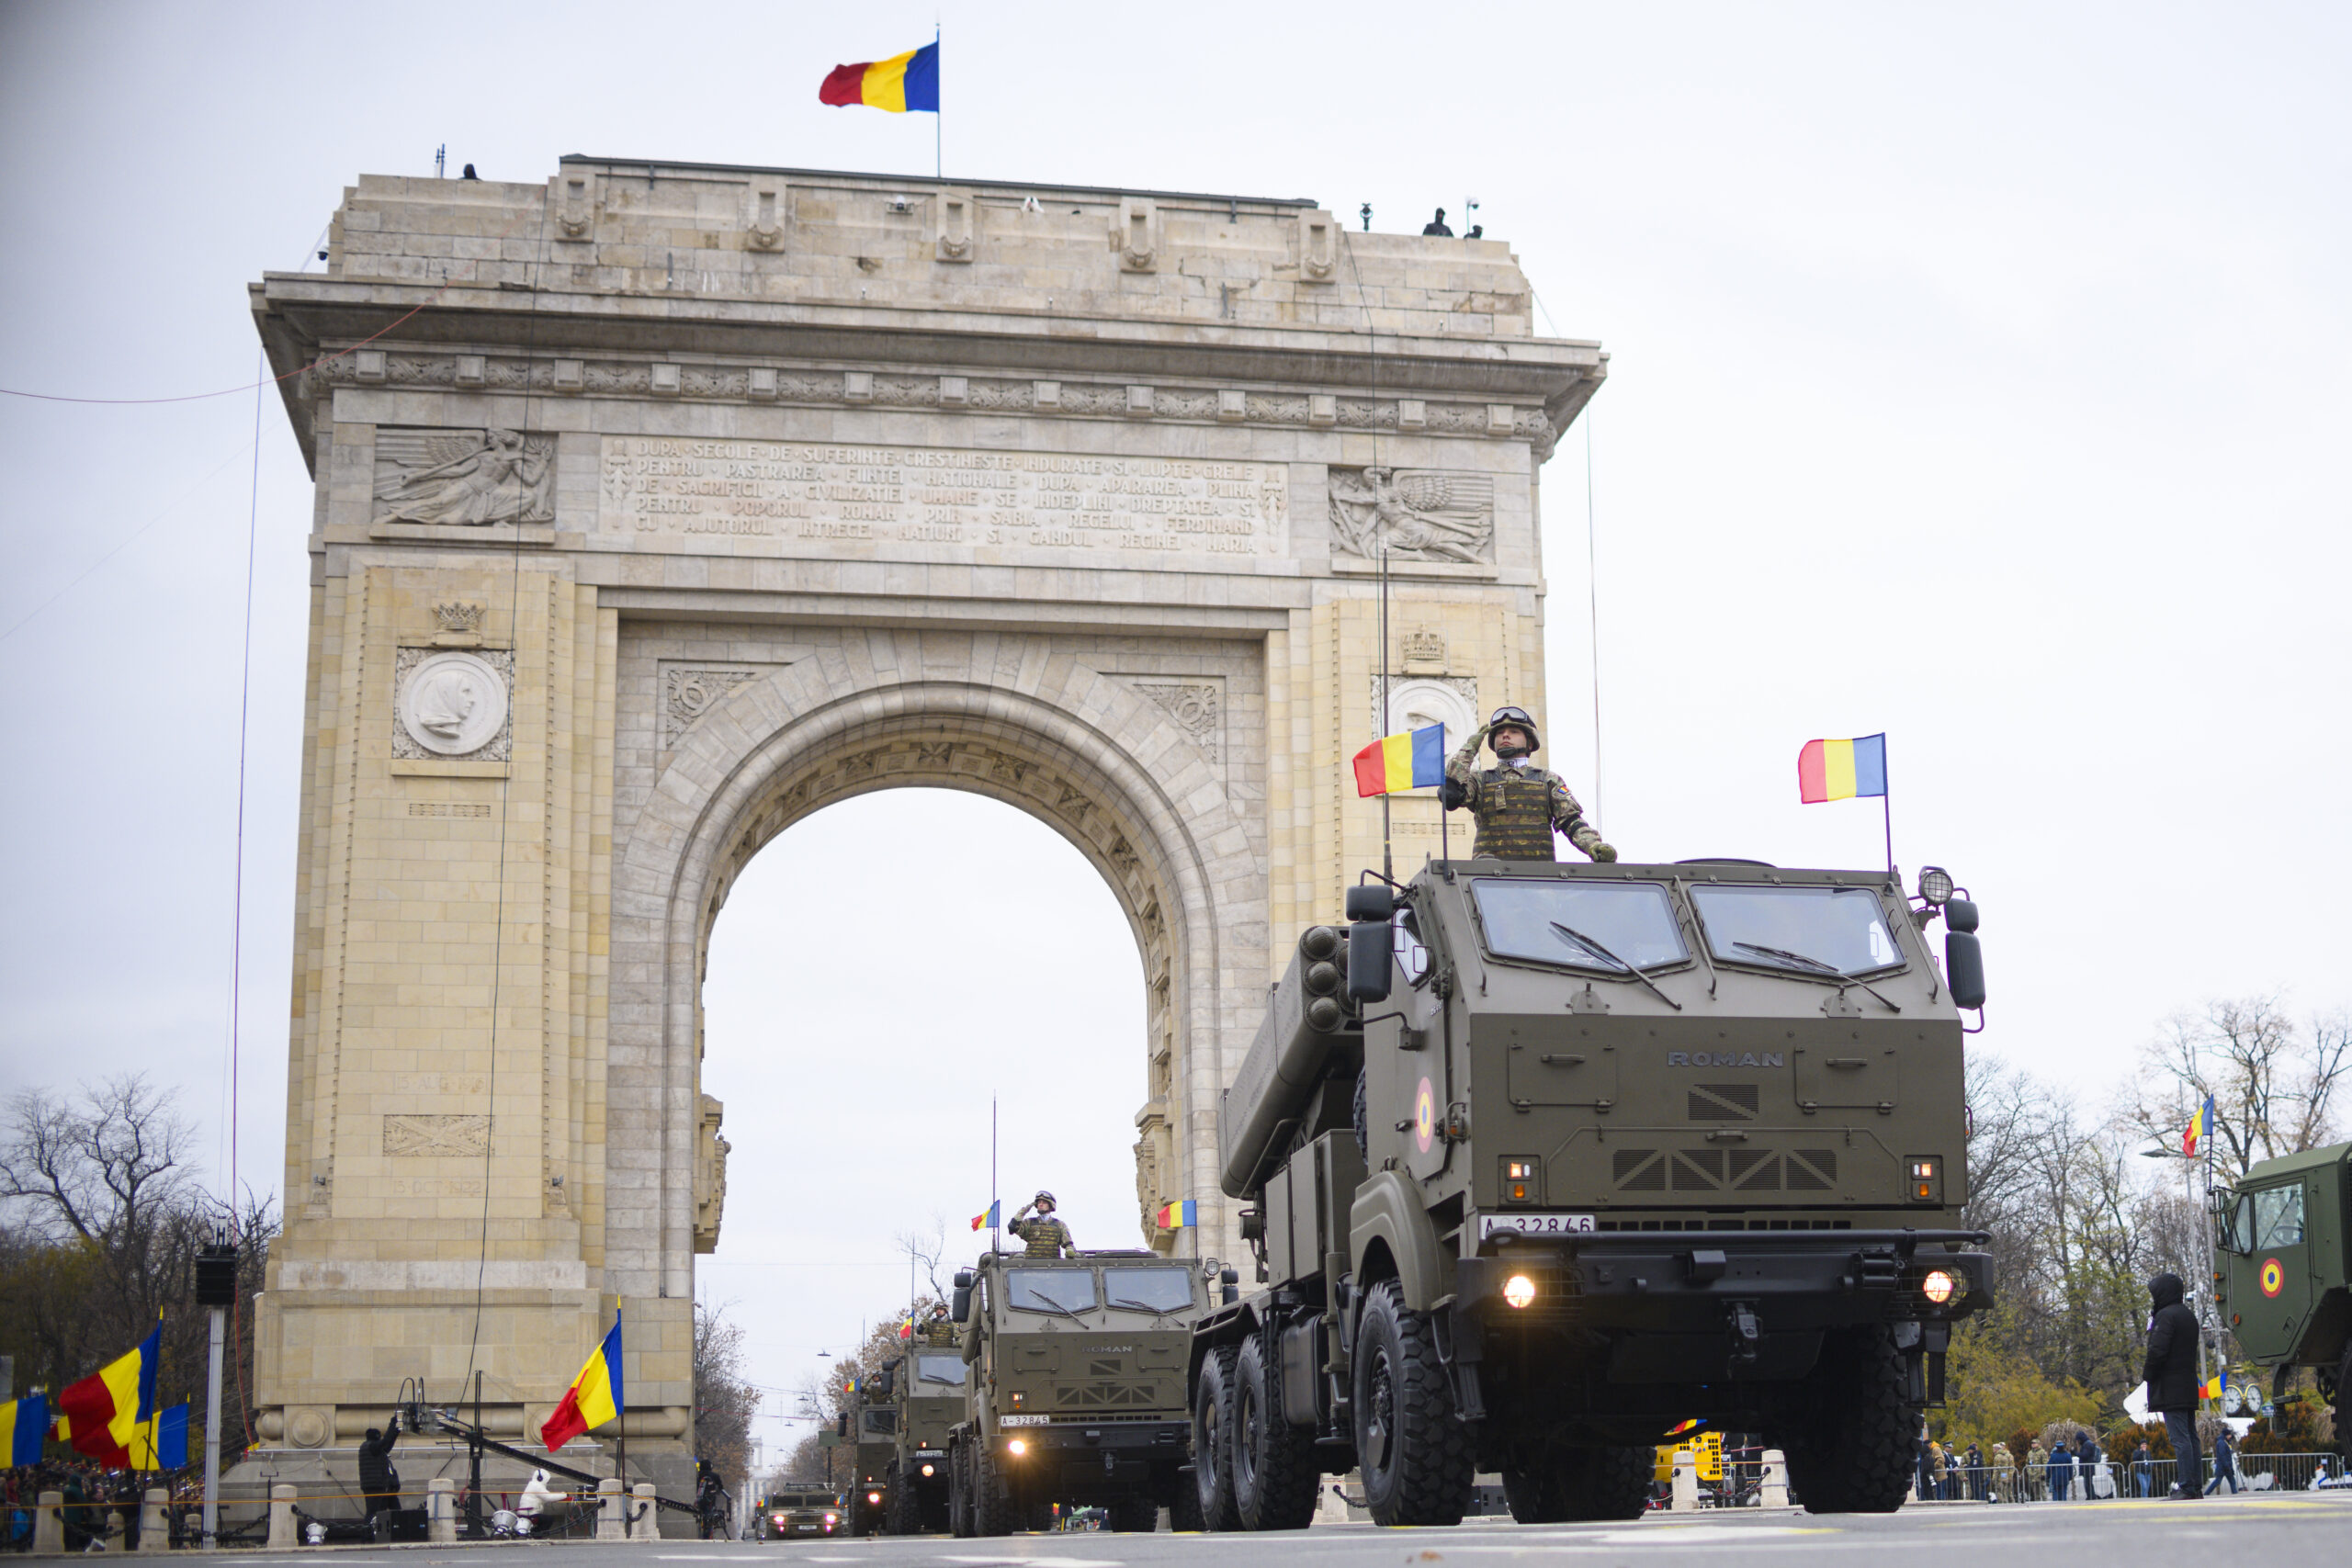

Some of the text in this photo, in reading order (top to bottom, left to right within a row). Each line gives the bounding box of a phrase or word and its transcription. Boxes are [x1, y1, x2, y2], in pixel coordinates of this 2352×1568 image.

[637, 441, 681, 457] DUPA
[693, 443, 757, 460] SECOLE
[769, 446, 791, 462] DE
[1139, 463, 1193, 479] LUPTE
[1203, 466, 1254, 481] GRELE
[636, 479, 659, 494] DE
[777, 484, 790, 500] A
[995, 492, 1017, 508] SE
[1131, 497, 1222, 516] DREPTATEA
[637, 460, 705, 477] PENTRU
[725, 464, 825, 481] PASTRAREA
[1038, 476, 1080, 492] DUPA
[1099, 479, 1187, 497] APARAREA
[1207, 483, 1257, 500] PLINA
[635, 517, 658, 532] CU
[684, 518, 774, 536] AJUTORUL
[1206, 536, 1257, 554] MARIA
[636, 498, 703, 514] PENTRU
[732, 501, 810, 519] POPORUL
[924, 508, 962, 525] PRIN
[990, 511, 1041, 527] SABIA
[1069, 513, 1135, 530] REGELUI
[1164, 517, 1255, 536] FERDINAND
[1668, 1051, 1784, 1067] ROMAN
[1080, 1345, 1133, 1353] ROMAN
